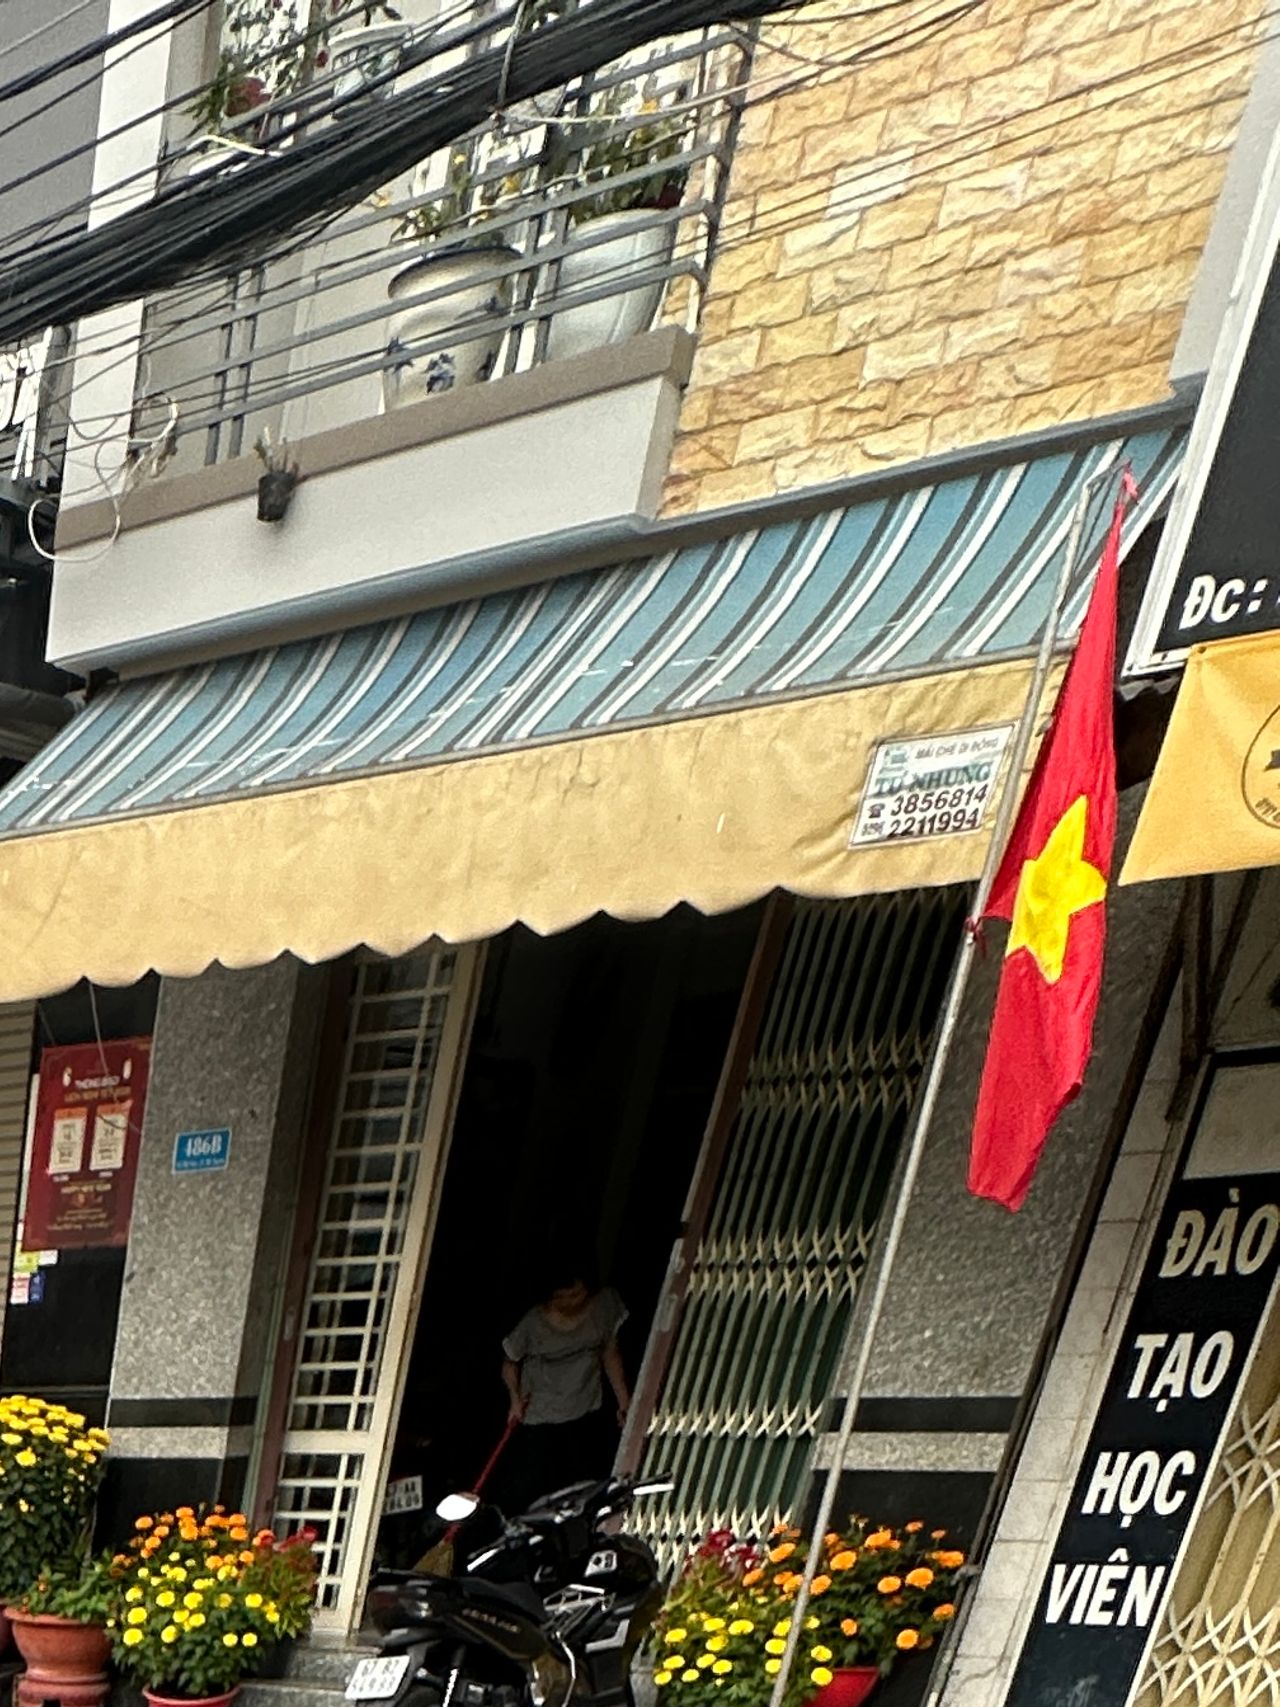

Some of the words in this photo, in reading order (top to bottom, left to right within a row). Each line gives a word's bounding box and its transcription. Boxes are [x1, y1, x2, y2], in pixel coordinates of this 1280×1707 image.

[887, 807, 979, 838] 2211994
[890, 784, 988, 816] 3856814
[1159, 1188, 1279, 1278] ĐÀO
[1127, 1329, 1234, 1413] TẠO
[1081, 1450, 1196, 1528] HỌC
[1045, 1547, 1165, 1628] VIÊN
